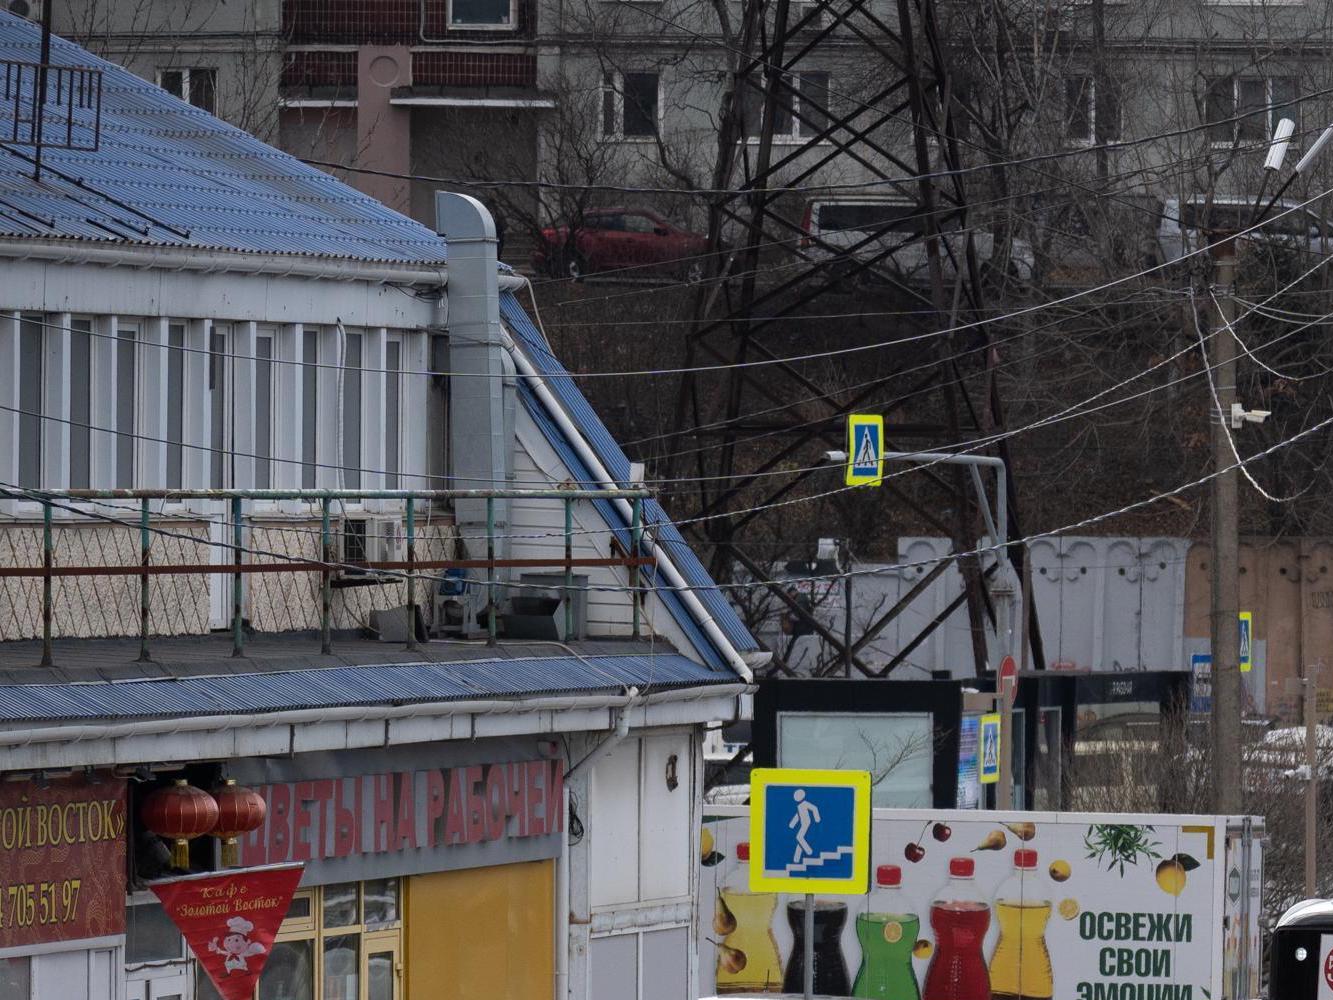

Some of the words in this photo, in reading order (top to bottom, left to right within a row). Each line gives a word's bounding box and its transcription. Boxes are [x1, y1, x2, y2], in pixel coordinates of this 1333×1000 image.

[0, 796, 33, 850] ОЙ
[37, 799, 125, 846] ВОСТОК»
[374, 771, 416, 853] НА
[9, 884, 36, 928] 705
[40, 881, 57, 924] 51
[63, 879, 81, 923] 97
[200, 883, 248, 899] Кафе
[1079, 911, 1193, 942] ОСВЕЖИ
[1099, 947, 1171, 977] СВОИ
